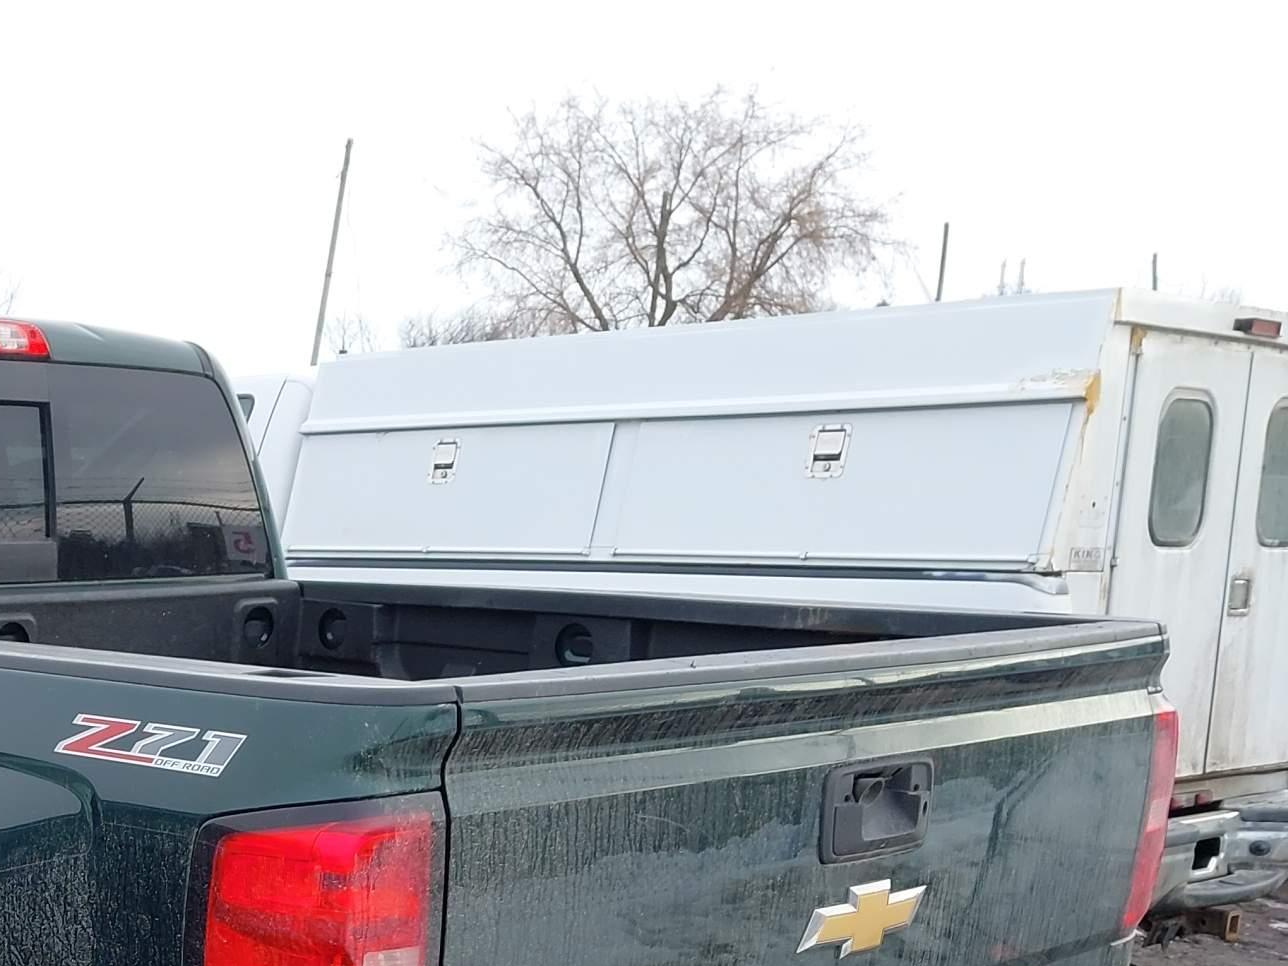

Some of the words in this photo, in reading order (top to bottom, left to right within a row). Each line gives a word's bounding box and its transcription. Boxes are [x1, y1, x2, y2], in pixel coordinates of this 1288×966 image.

[54, 713, 248, 767] Z71
[153, 758, 180, 770] OFF
[183, 762, 222, 775] ROAD
